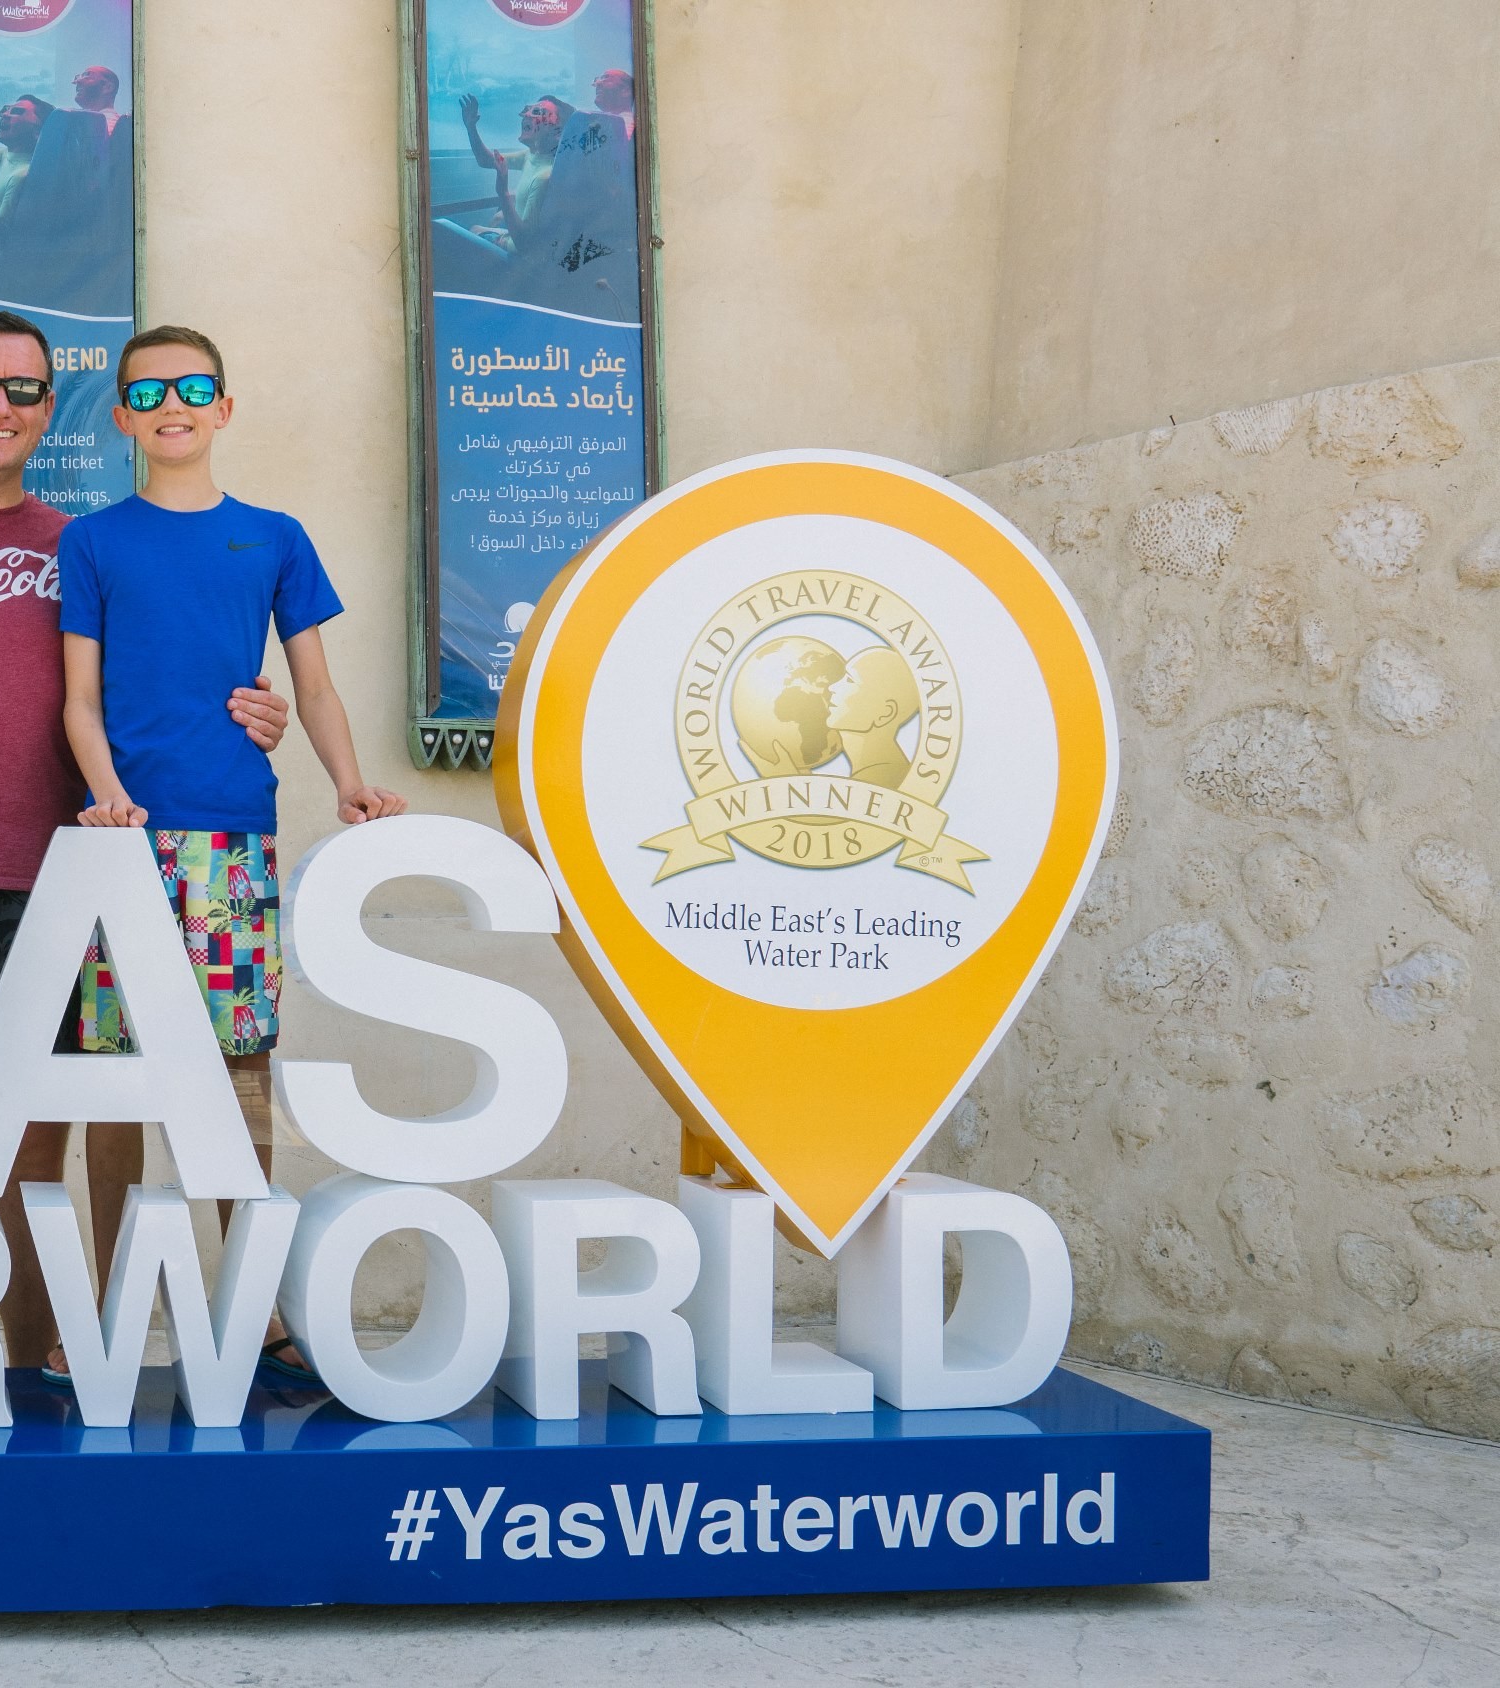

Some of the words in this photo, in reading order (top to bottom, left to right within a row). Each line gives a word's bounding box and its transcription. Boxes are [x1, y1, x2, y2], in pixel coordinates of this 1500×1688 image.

[53, 347, 107, 371] GEND
[451, 345, 570, 376] الأسطورة
[567, 382, 634, 416] بأبعاد
[458, 434, 500, 452] شامل
[506, 435, 573, 455] الترفيهي
[578, 437, 626, 455] المرفق
[60, 455, 104, 469] ticket
[565, 462, 591, 481] في
[41, 488, 111, 505] bookings,
[451, 486, 490, 503] يرجى
[496, 485, 568, 503] والحجوزات
[573, 486, 634, 504] للمواعيد
[488, 510, 526, 524] خدمة
[530, 509, 562, 528] مركز
[567, 511, 599, 528] زيارة
[530, 535, 565, 552] داخل
[684, 626, 735, 782] WORLD
[738, 578, 882, 627] TRAVEL
[889, 620, 952, 785] AWARDS
[714, 781, 915, 832] WINNER
[765, 823, 863, 861] 2018
[665, 902, 762, 931] Middle
[770, 905, 845, 934] East's
[854, 908, 962, 947] Leading
[744, 940, 822, 968] Water
[830, 942, 890, 970] Park
[385, 1472, 1118, 1562] #YasWaterworld
